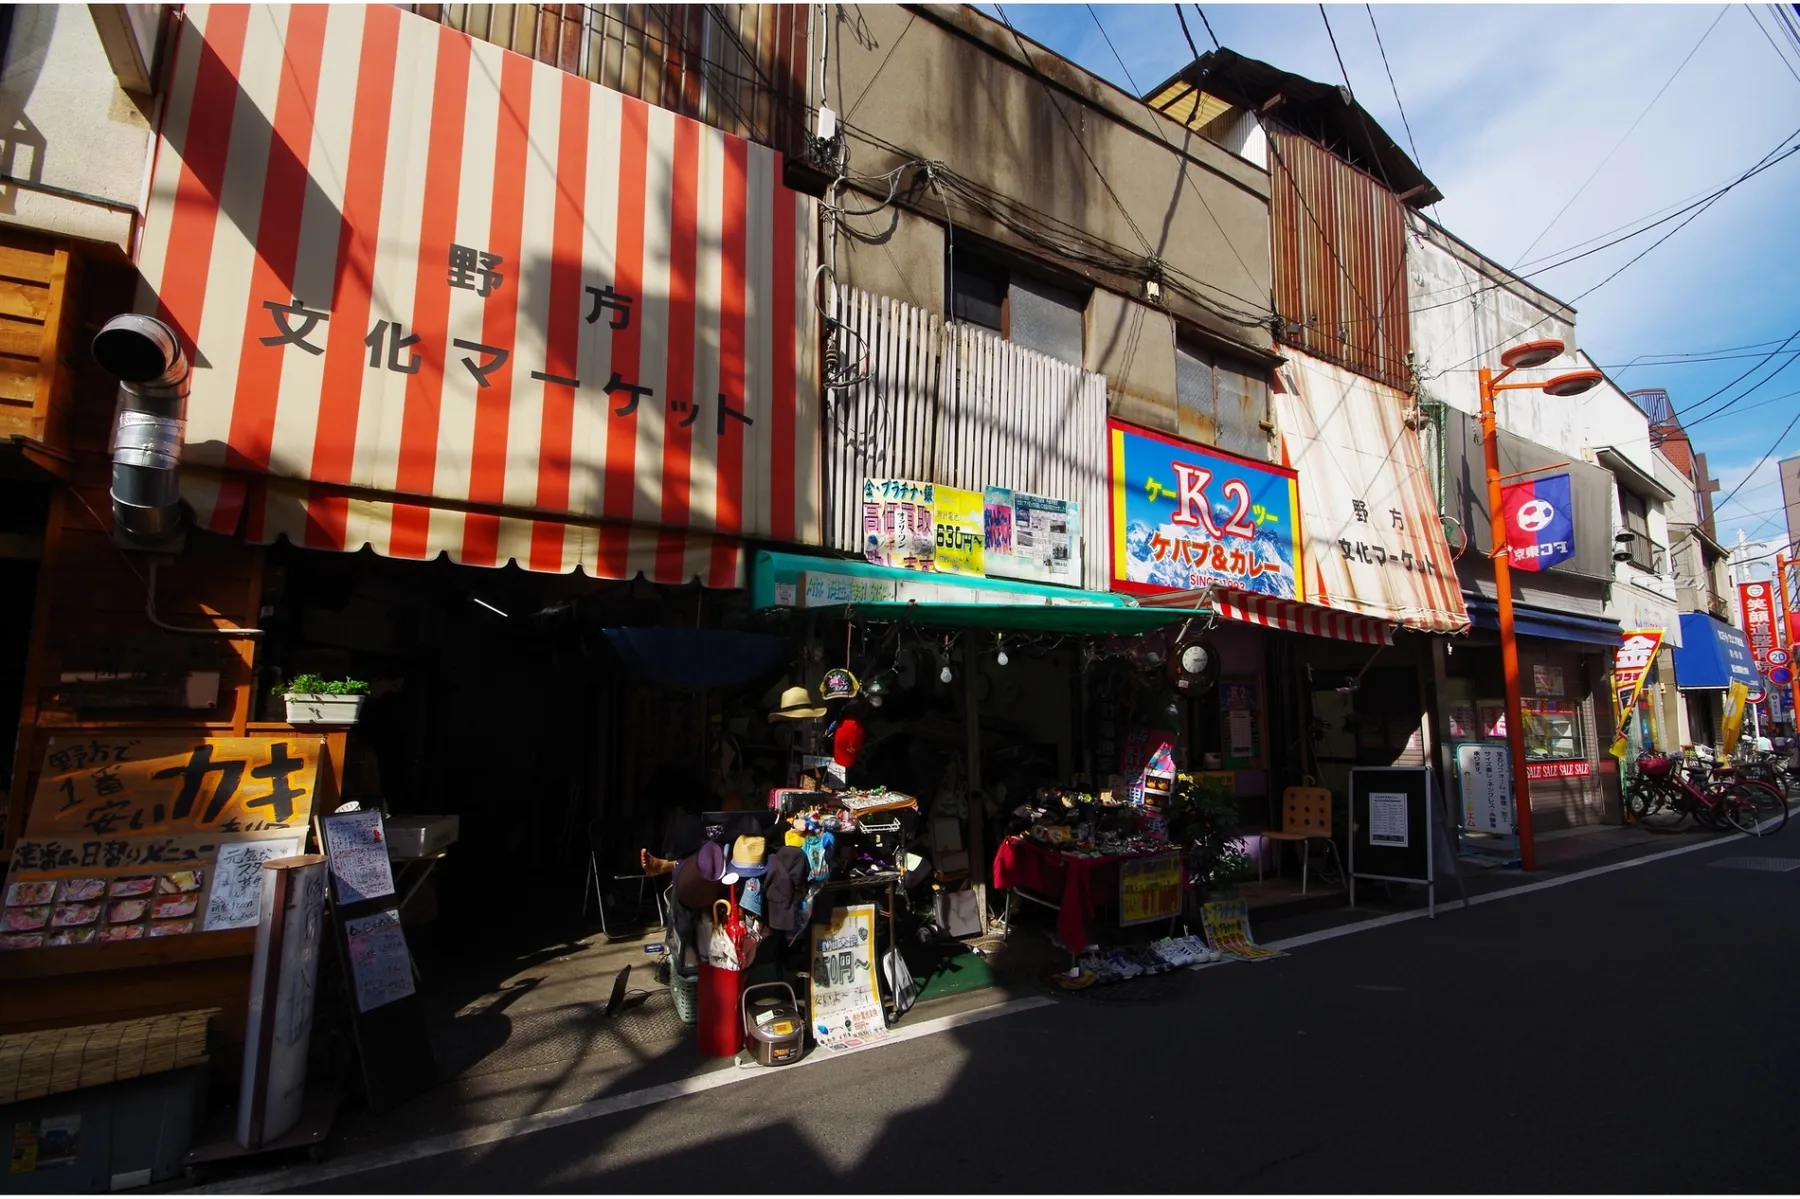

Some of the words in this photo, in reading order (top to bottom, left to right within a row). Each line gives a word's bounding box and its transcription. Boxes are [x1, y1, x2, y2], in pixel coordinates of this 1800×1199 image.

[448, 243, 632, 329] 野方
[259, 299, 753, 435] 文化マーケット
[1145, 477, 1177, 502] ケー
[1170, 460, 1254, 540] K2
[1252, 504, 1278, 526] ツー
[1352, 499, 1404, 531] 野方
[1149, 532, 1281, 579] ケバブ&カレー
[1338, 538, 1437, 575] 文化マーケット
[1615, 636, 1656, 669] 金
[1771, 653, 1786, 662] 20
[152, 742, 307, 823] カキ
[1542, 765, 1558, 777] SALE
[1559, 764, 1574, 776] SALE
[1574, 763, 1588, 775] SALE
